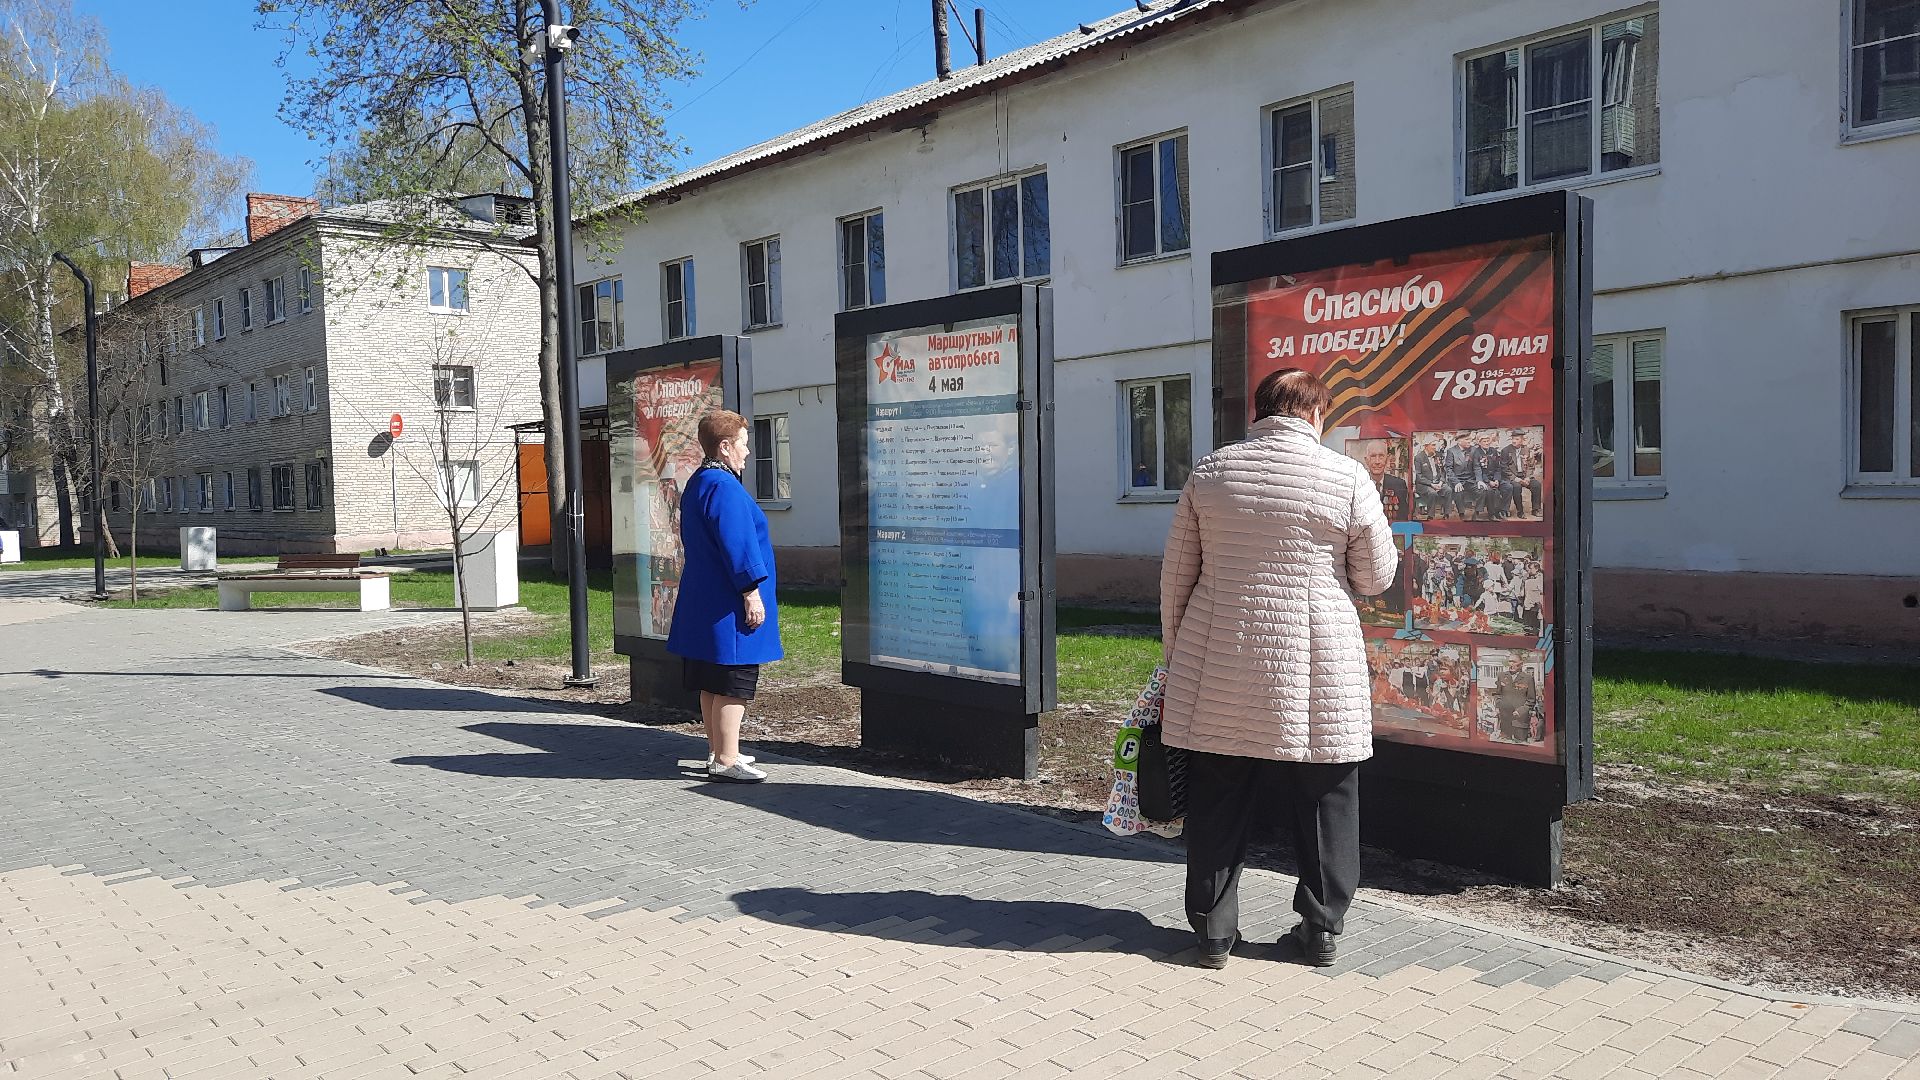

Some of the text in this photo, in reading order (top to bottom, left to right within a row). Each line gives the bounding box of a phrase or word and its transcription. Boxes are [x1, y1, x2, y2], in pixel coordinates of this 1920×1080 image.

[1303, 274, 1444, 324] Спасибо
[927, 325, 1018, 353] Маршрутный л
[1266, 323, 1407, 359] ЗА ПОБЕДУ!
[1470, 333, 1549, 365] 9 МАЯ
[928, 349, 1000, 372] автопробега
[655, 374, 702, 399] Спасибо
[928, 375, 937, 393] 4
[941, 376, 964, 392] мая
[1431, 368, 1534, 401] 78 лет
[876, 529, 900, 541] Маршрут
[901, 530, 906, 540] 2
[1123, 741, 1136, 757] F
